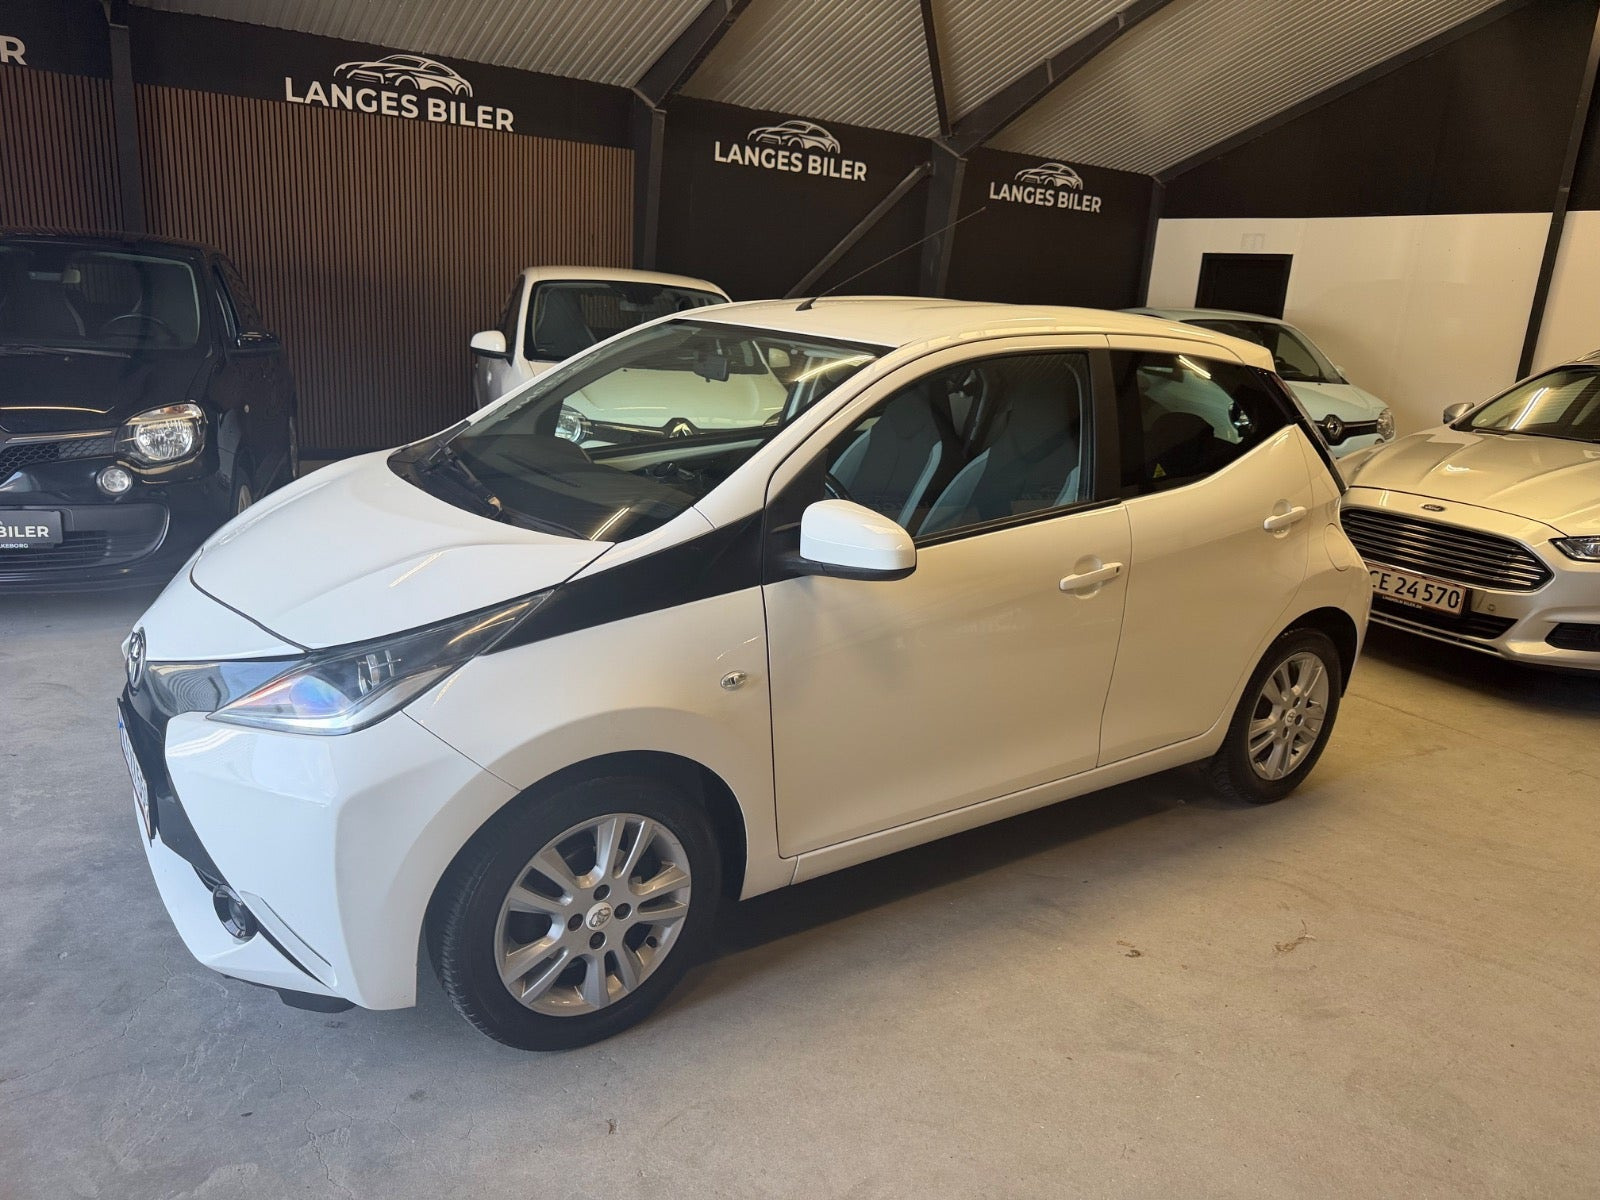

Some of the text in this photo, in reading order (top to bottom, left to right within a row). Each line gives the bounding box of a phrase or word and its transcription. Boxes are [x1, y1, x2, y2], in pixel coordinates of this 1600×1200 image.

[285, 76, 514, 132] LANGES BILER
[714, 140, 867, 182] LANGES BILER
[989, 181, 1102, 214] LANGES BILER
[0, 525, 49, 538] BILER
[1394, 576, 1419, 599] 24
[1421, 583, 1460, 609] 570
